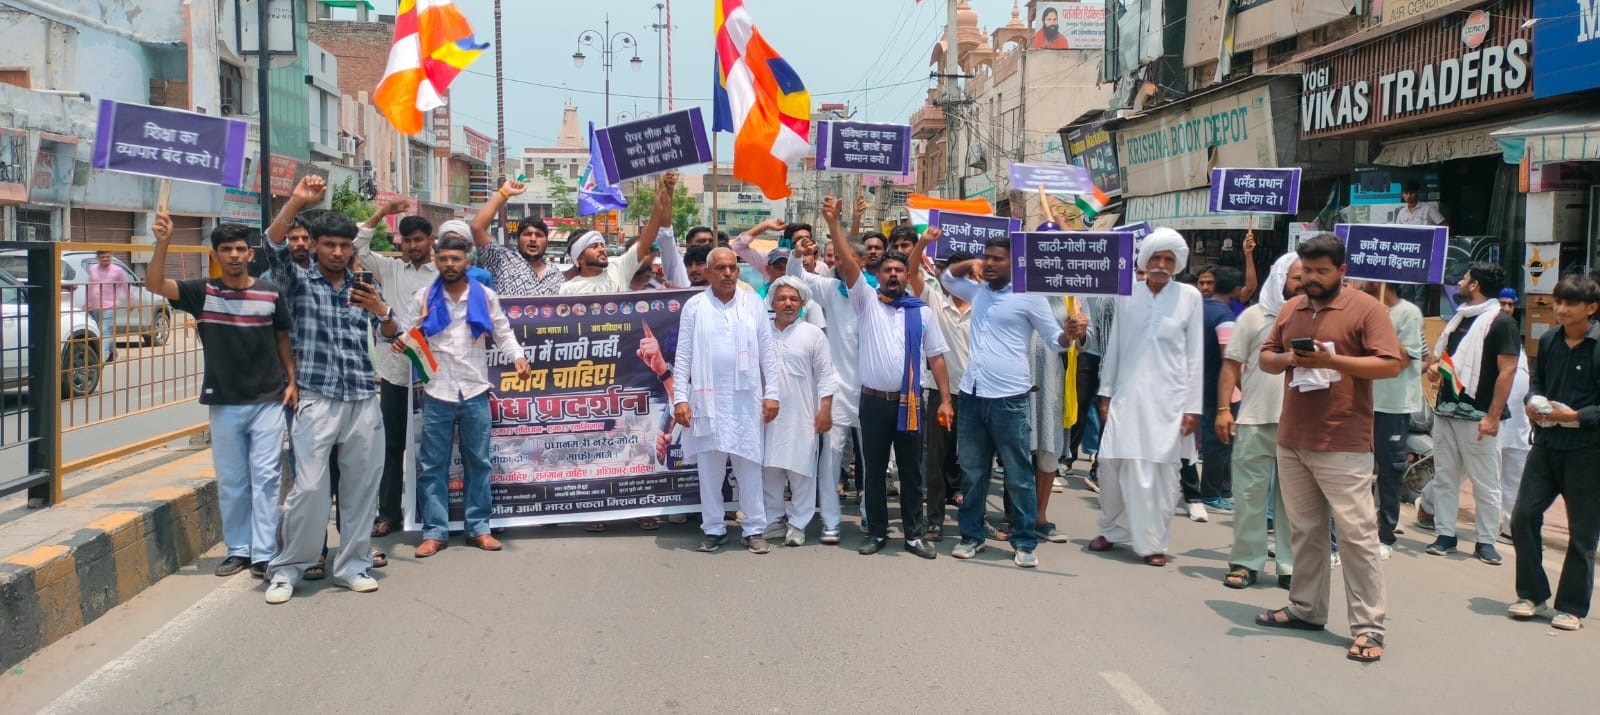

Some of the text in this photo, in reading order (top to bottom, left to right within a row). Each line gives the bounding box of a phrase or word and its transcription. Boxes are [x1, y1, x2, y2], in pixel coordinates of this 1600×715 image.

[1302, 67, 1329, 91] YOGI
[1302, 39, 1528, 131] VIKAS TRADERS
[144, 121, 199, 145] शिक्षा का
[624, 124, 677, 142] पेपर लीक बंद
[840, 127, 897, 140] संविधान का मान
[1127, 106, 1248, 165] KRISHNA BOOK DEPOT
[626, 144, 646, 156] करो,
[842, 139, 893, 152] करो, छात्रों का
[115, 142, 159, 160] व्यापार
[161, 146, 183, 164] बंद
[185, 150, 212, 168] करो
[647, 155, 660, 165] बंद
[662, 149, 678, 161] करो
[844, 153, 868, 163] सम्मान
[870, 153, 885, 163] करो
[1234, 175, 1284, 189] धर्मेंद्र प्रधान
[1129, 194, 1176, 219] KRISHNA
[1229, 191, 1264, 205] इस्तीफा
[1266, 192, 1278, 205] दो
[941, 222, 1006, 239] युवाओं का हक
[949, 237, 985, 254] देना होग
[1037, 238, 1108, 253] लाठी-गोली नहीं
[1360, 238, 1421, 253] छात्रों का अपमान
[1034, 256, 1064, 271] चलेगी,
[1066, 257, 1110, 271] तानाशाही
[1350, 252, 1366, 264] नहीं
[1366, 252, 1387, 266] सहेगा
[1388, 254, 1421, 269] हिंदुस्तान
[1045, 274, 1063, 288] नहीं
[1065, 274, 1092, 287] चलेगी
[538, 339, 554, 362] में
[554, 336, 590, 361] लाठी
[591, 334, 622, 359] नहीं,
[536, 385, 651, 421] प्रदर्शन
[545, 502, 573, 511] भारत
[576, 500, 604, 509] एकता
[607, 497, 637, 507] मिशन
[639, 494, 682, 505] हरियाणा
